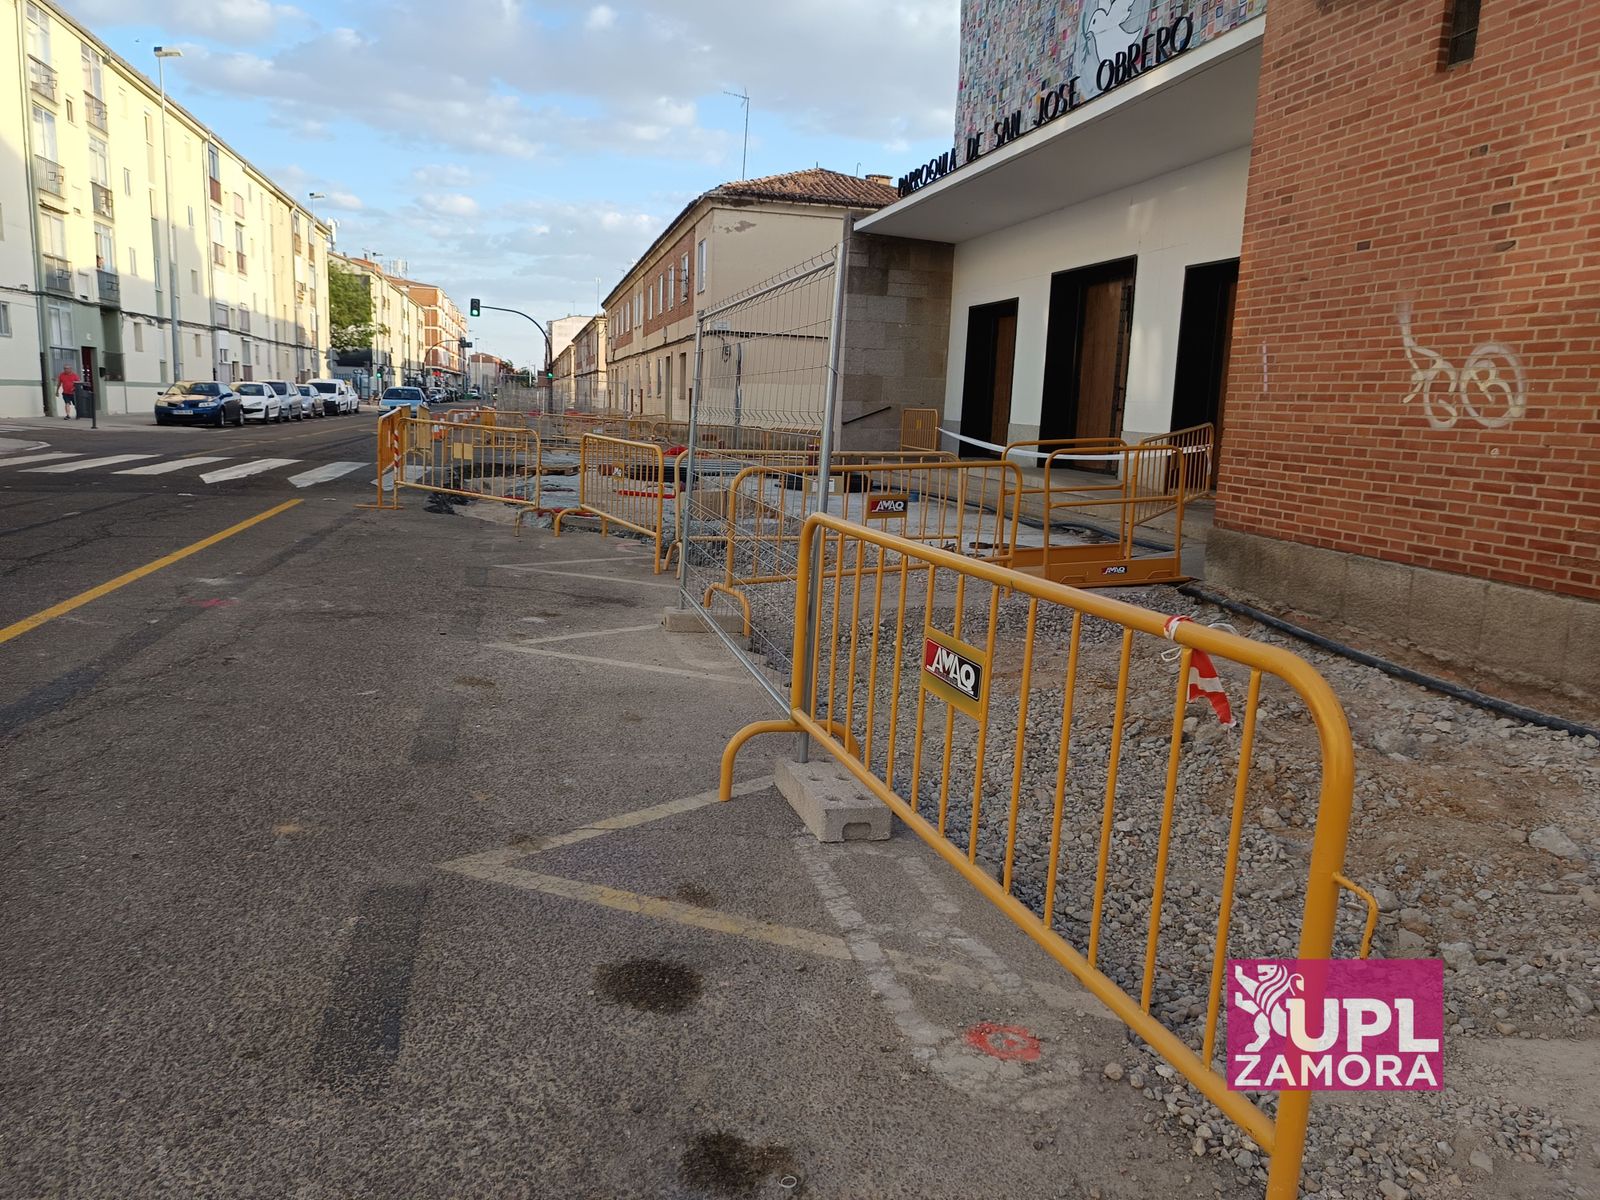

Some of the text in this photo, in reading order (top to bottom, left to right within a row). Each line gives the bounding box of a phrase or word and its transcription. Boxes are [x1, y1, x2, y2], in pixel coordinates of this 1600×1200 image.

[898, 147, 958, 198] PARROQUIA
[966, 131, 984, 162] DE
[994, 110, 1022, 148] SAN
[1096, 16, 1194, 92] OBRERO
[872, 500, 905, 512] AMAQ
[926, 647, 976, 696] AMAQ
